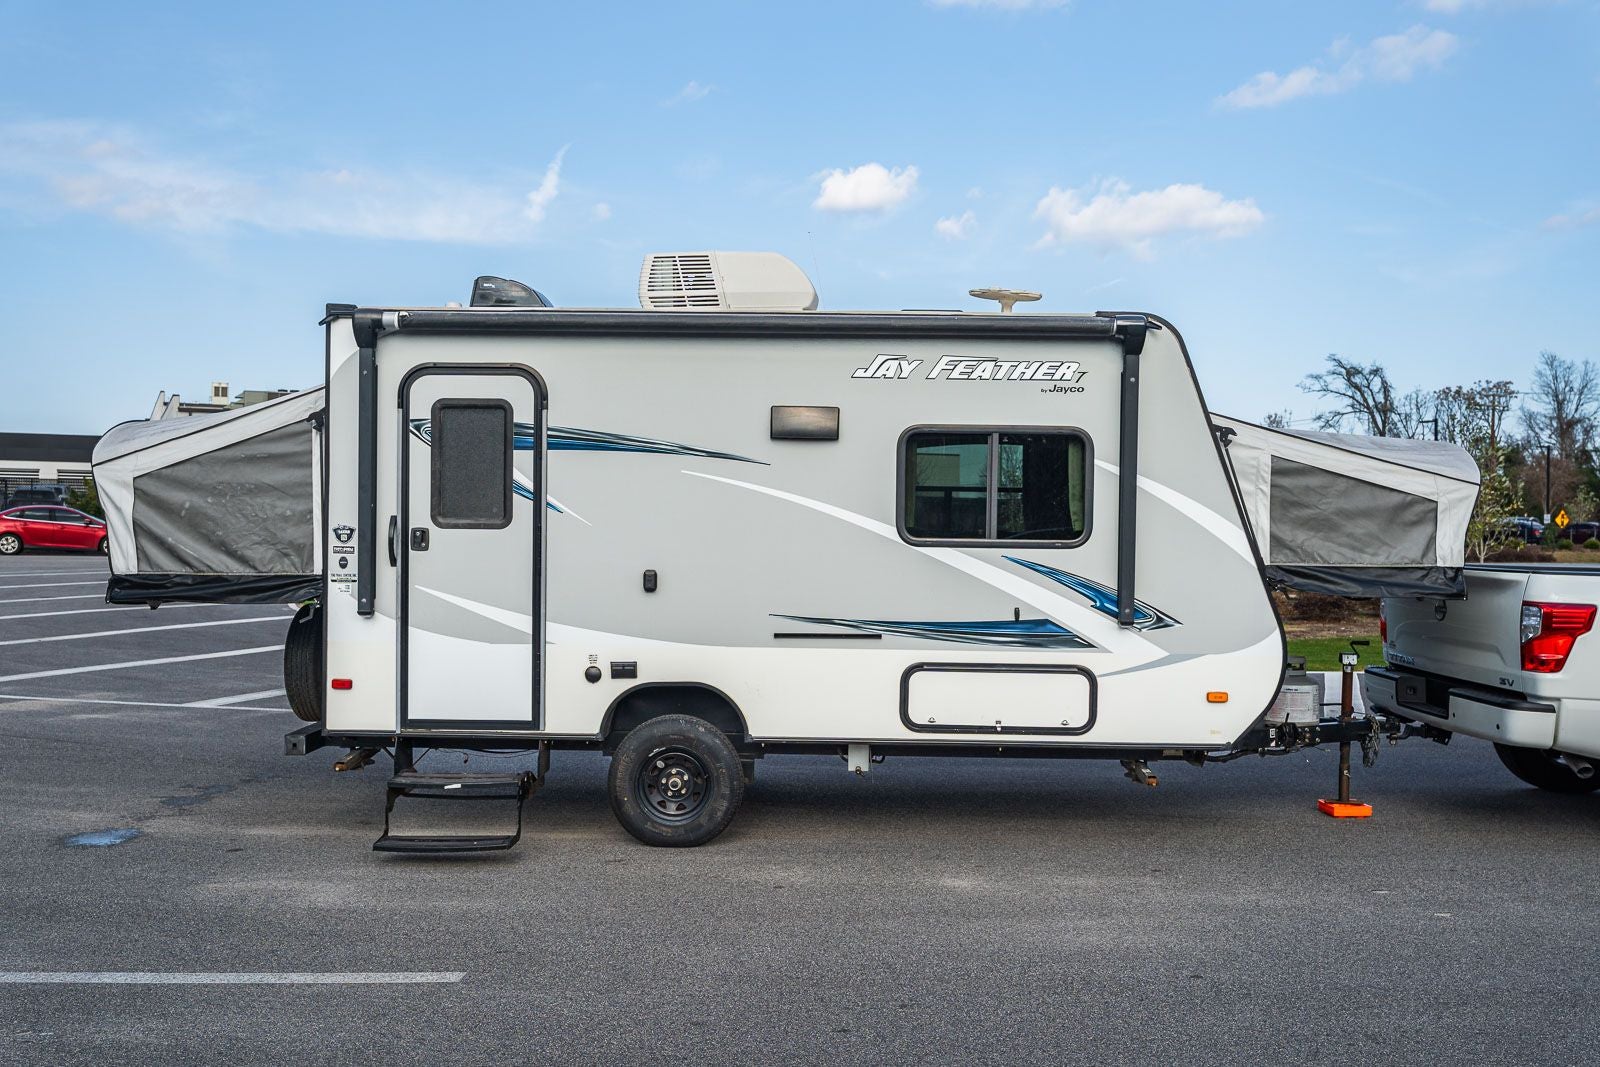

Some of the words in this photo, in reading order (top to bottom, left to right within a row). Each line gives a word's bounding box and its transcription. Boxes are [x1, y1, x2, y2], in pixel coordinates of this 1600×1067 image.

[851, 353, 924, 379] JAY
[925, 354, 1081, 382] FEATHER
[1075, 371, 1089, 384] 7
[1048, 384, 1085, 394] Jayco
[1498, 677, 1514, 687] SV
